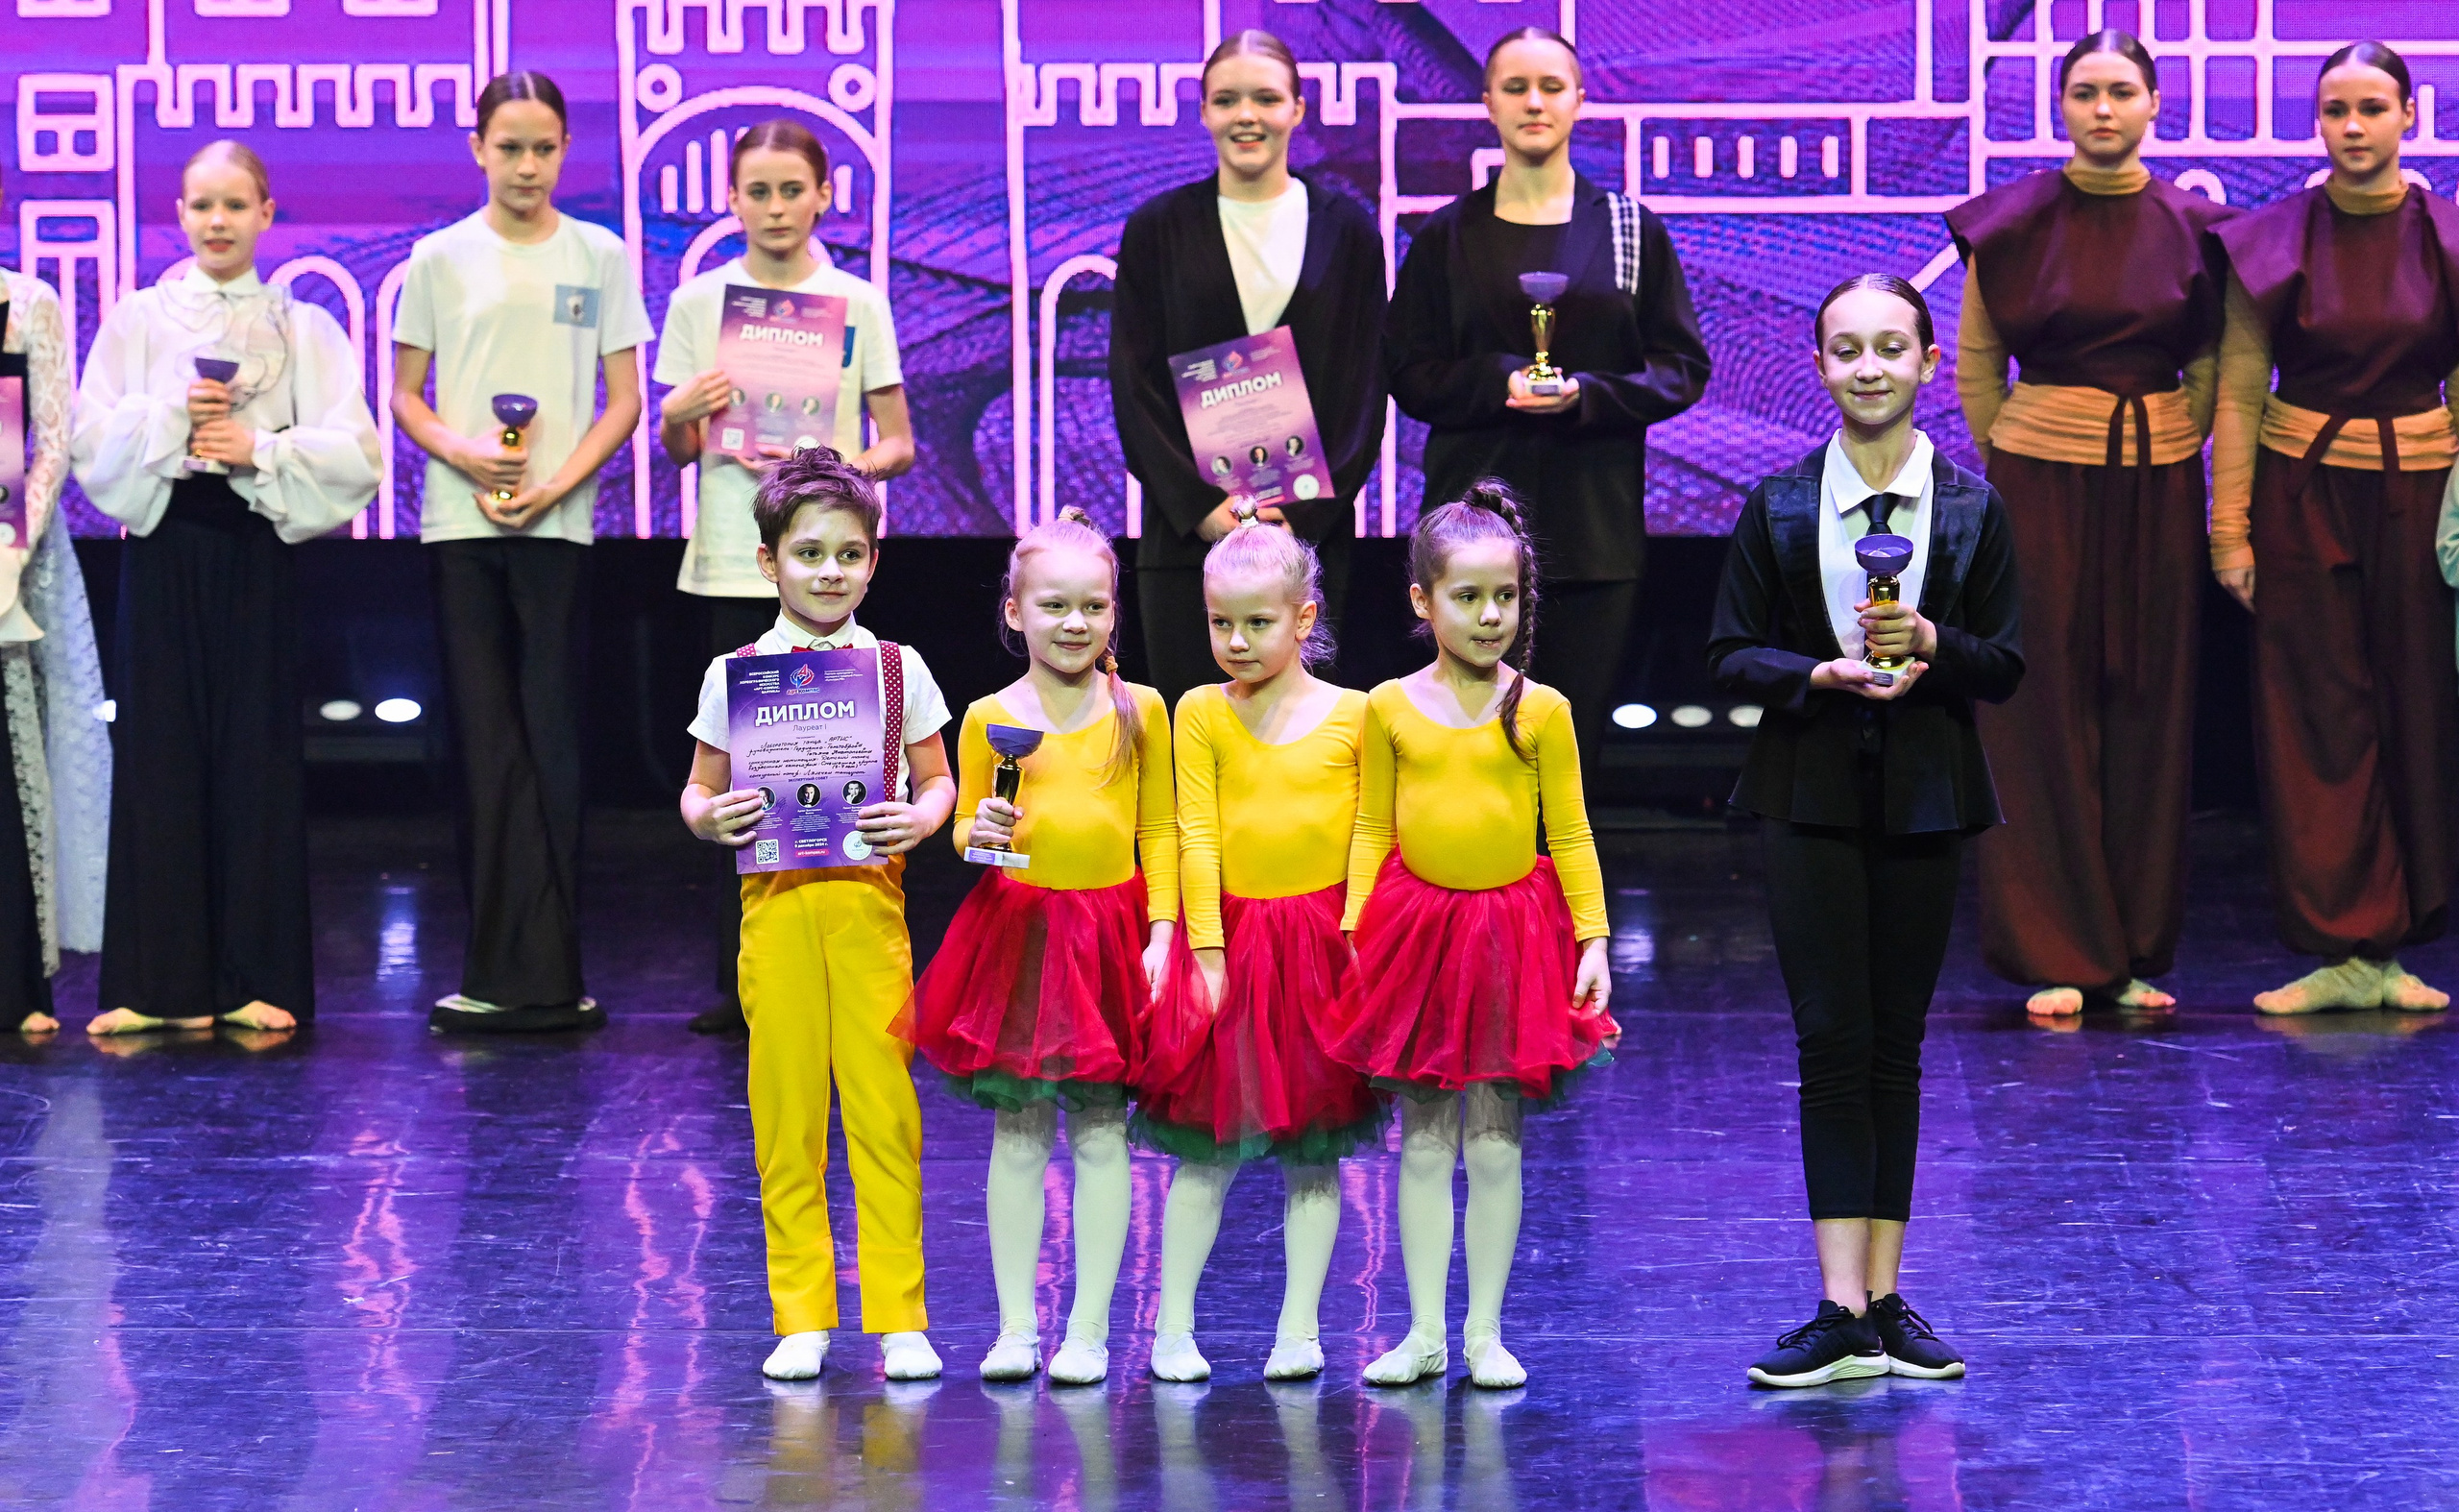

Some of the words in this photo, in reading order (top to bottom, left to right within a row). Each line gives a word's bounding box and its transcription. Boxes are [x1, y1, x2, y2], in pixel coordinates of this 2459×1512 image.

[739, 324, 824, 346] ДИПЛОМ
[1201, 371, 1283, 409] ДИПЛОМ
[755, 700, 855, 727] ДИПЛОМ
